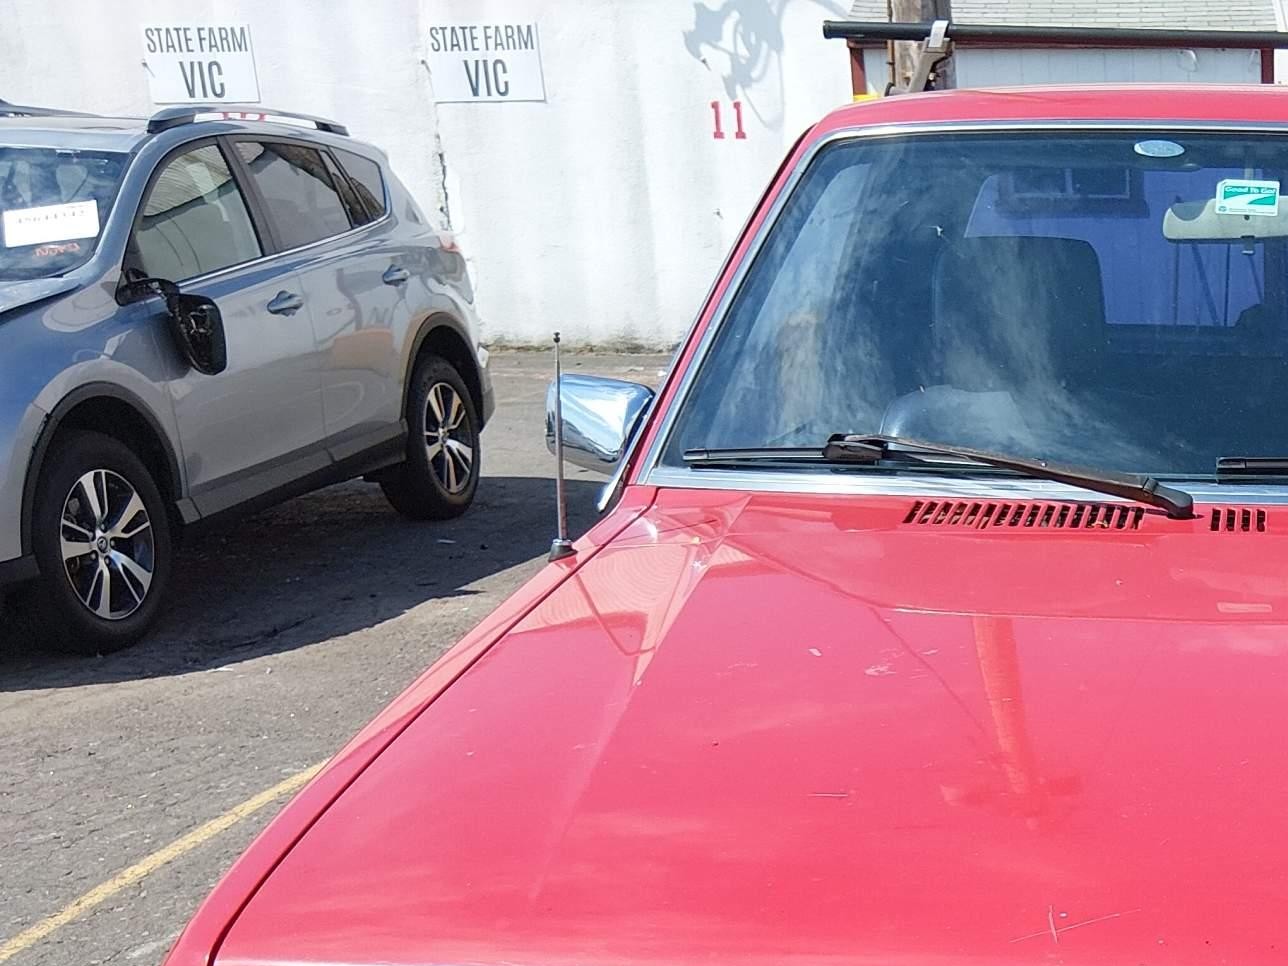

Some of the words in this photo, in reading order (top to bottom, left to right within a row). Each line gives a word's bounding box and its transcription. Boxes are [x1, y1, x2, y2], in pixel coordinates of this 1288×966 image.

[145, 27, 195, 53] STATE
[197, 26, 248, 53] FARM
[429, 26, 480, 52] STATE
[483, 24, 534, 51] FARM
[178, 60, 226, 99] VIC
[463, 58, 510, 97] VIC
[711, 100, 747, 140] 11
